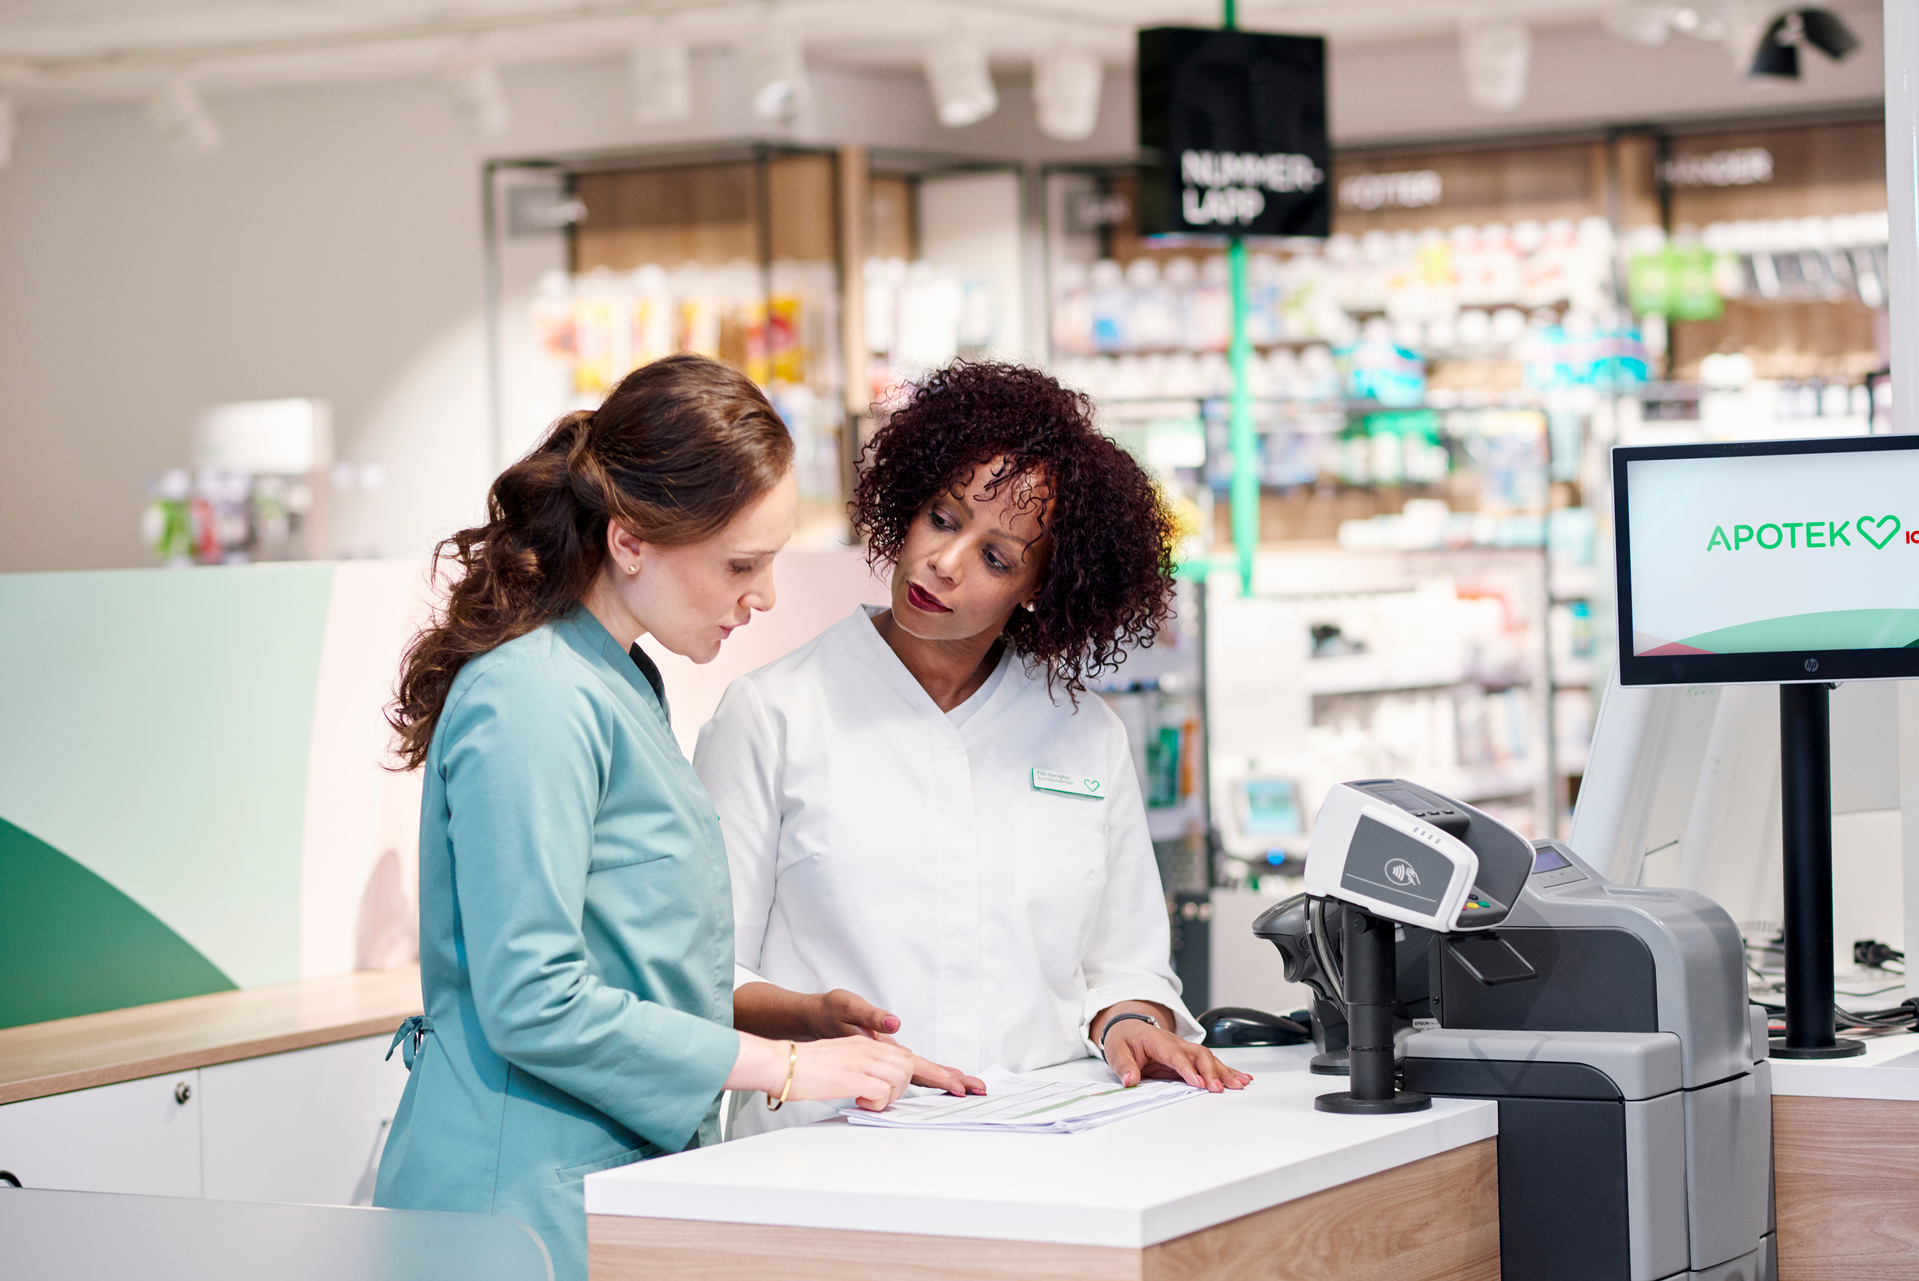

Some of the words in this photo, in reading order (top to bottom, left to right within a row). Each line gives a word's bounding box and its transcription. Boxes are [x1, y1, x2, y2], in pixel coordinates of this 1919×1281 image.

[1183, 186, 1265, 226] LAPP
[1706, 520, 1852, 552] APOTEK
[1804, 657, 1819, 673] hp
